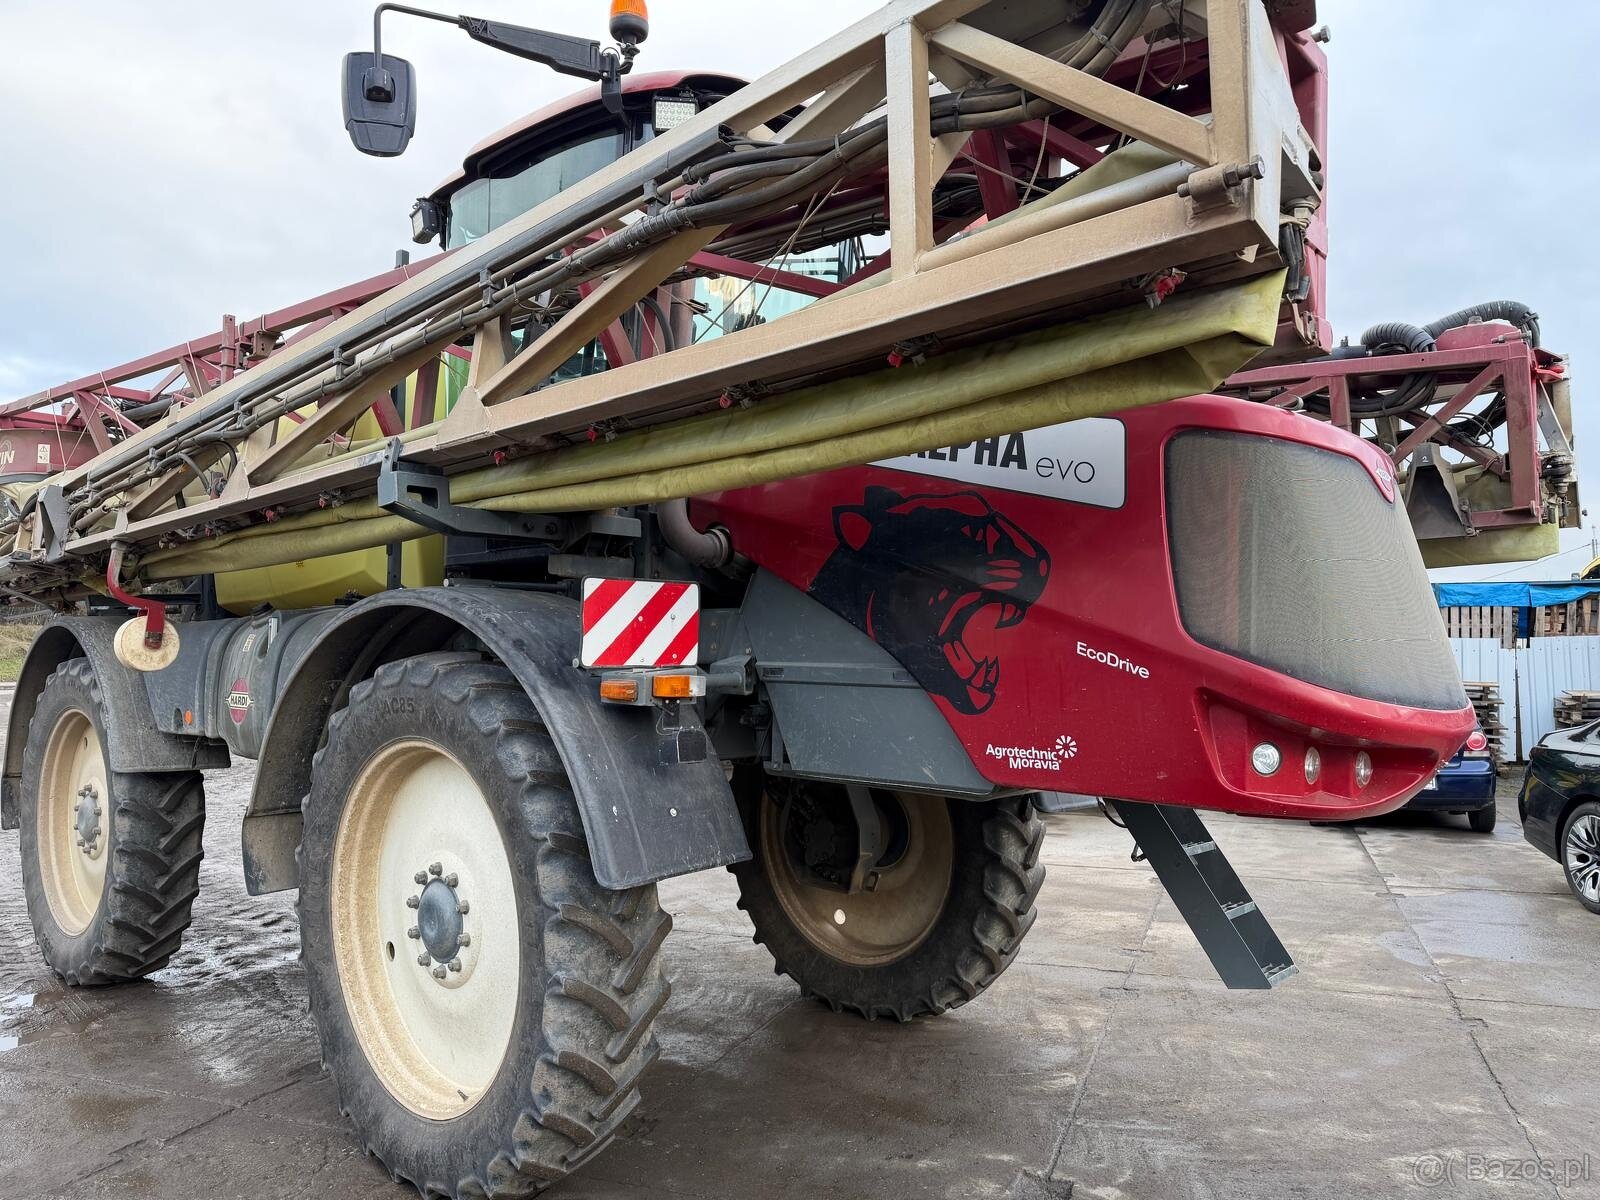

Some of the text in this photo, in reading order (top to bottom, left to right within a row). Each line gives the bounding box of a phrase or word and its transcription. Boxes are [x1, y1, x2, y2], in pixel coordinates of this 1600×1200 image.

[1036, 457, 1095, 483] evo
[1076, 641, 1150, 679] EcoDrive
[230, 695, 248, 706] HARDI
[383, 697, 415, 715] AC85
[986, 743, 1058, 760] Agrotechnic
[1009, 757, 1060, 770] Moravia
